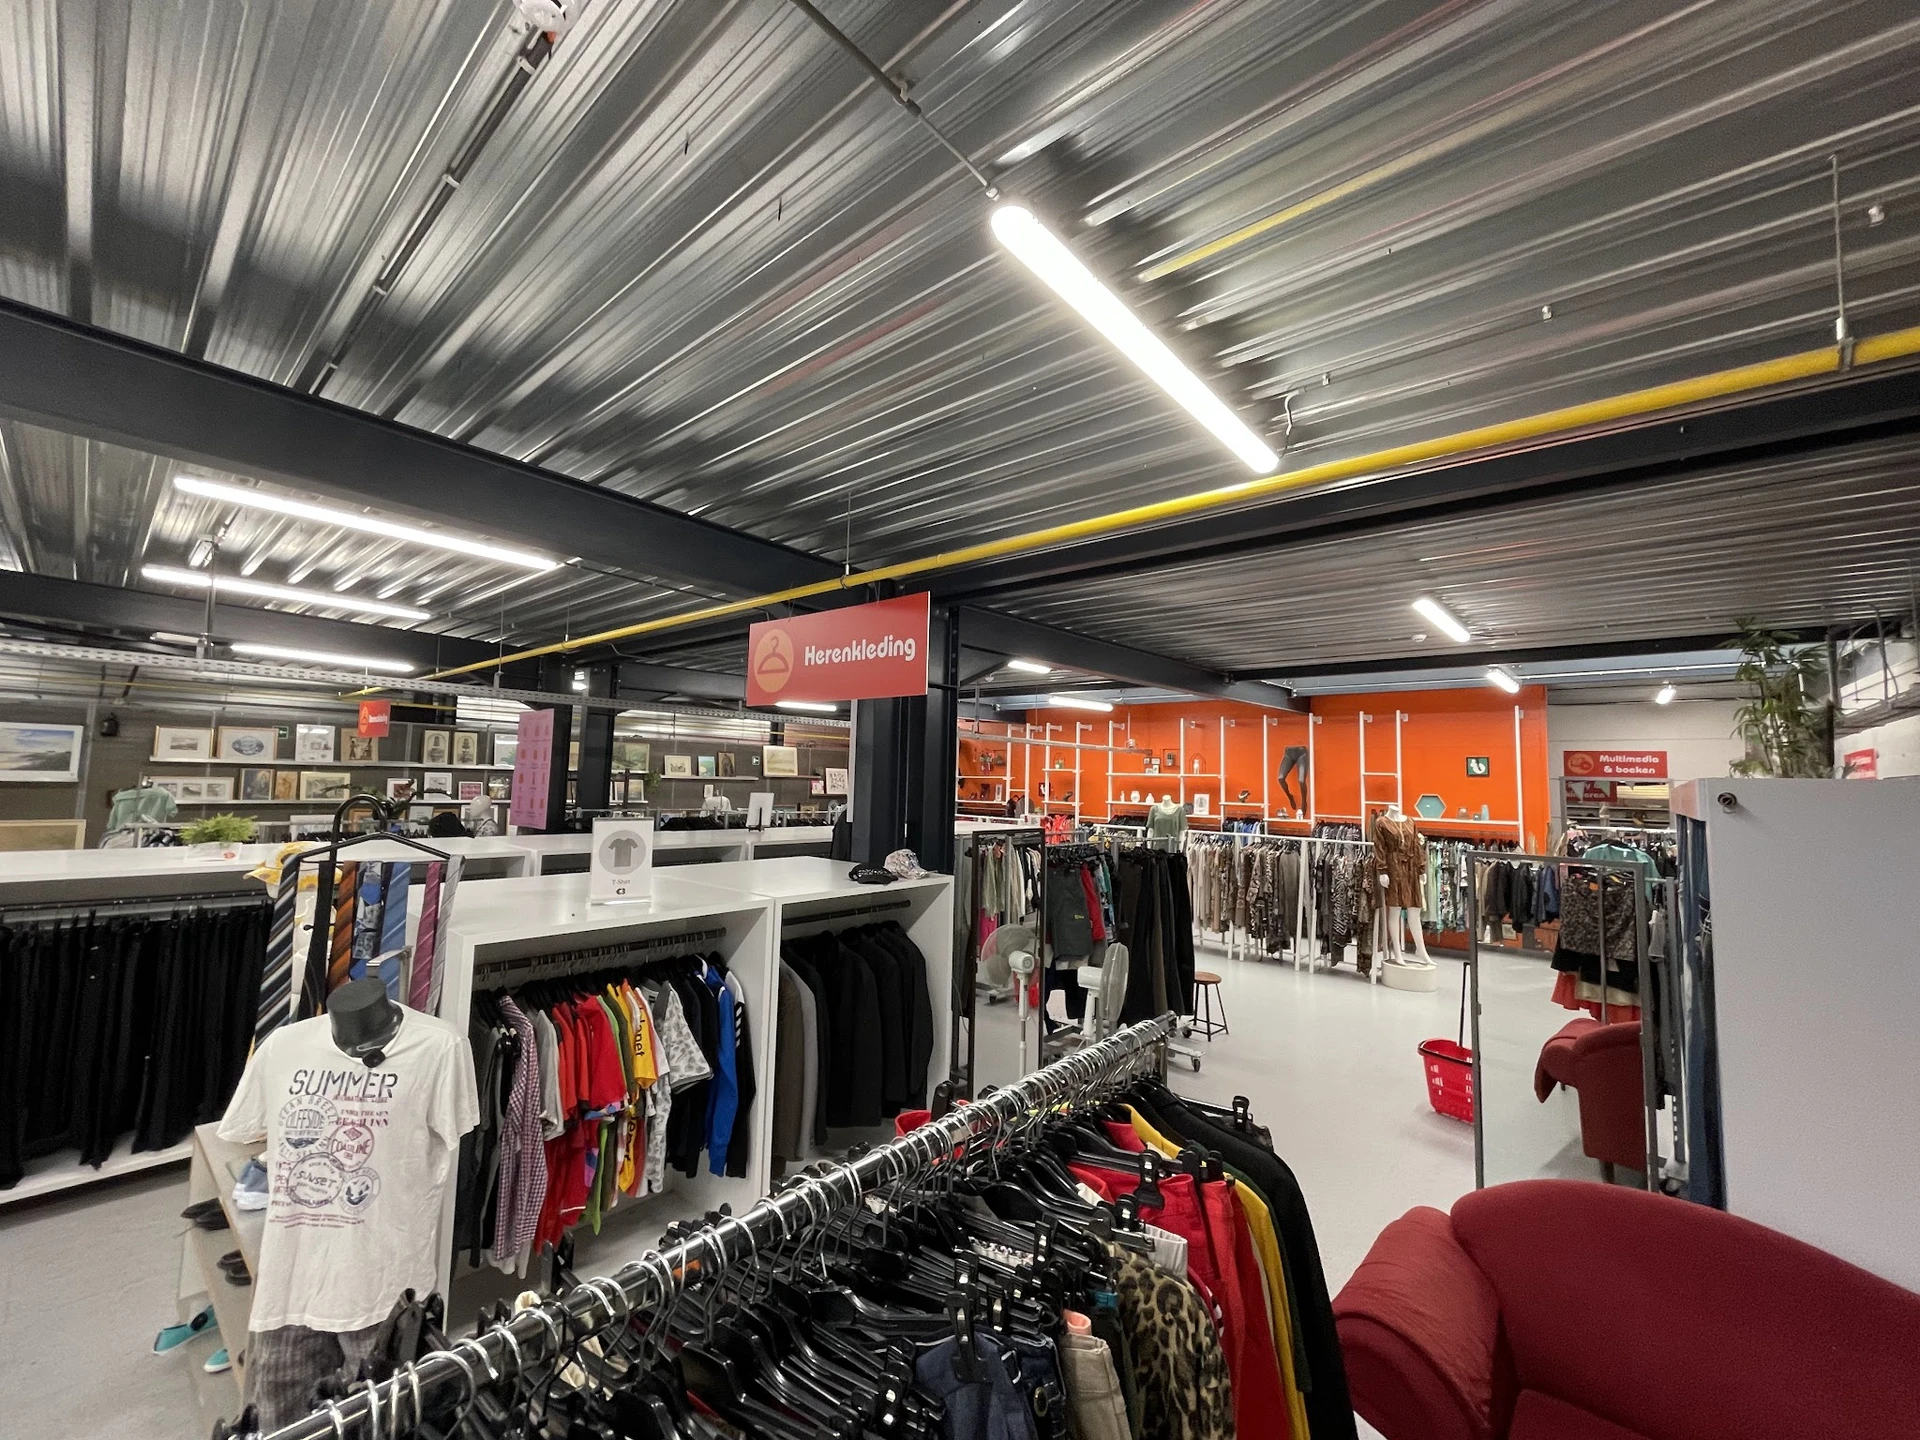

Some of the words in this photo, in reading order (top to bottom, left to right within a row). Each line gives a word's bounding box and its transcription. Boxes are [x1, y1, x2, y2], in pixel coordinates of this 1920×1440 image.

[804, 634, 916, 667] Herenkleding
[1599, 754, 1660, 763] Multimedia
[1603, 765, 1613, 774] &
[1615, 765, 1656, 774] boeken
[289, 1069, 398, 1099] SUMMER
